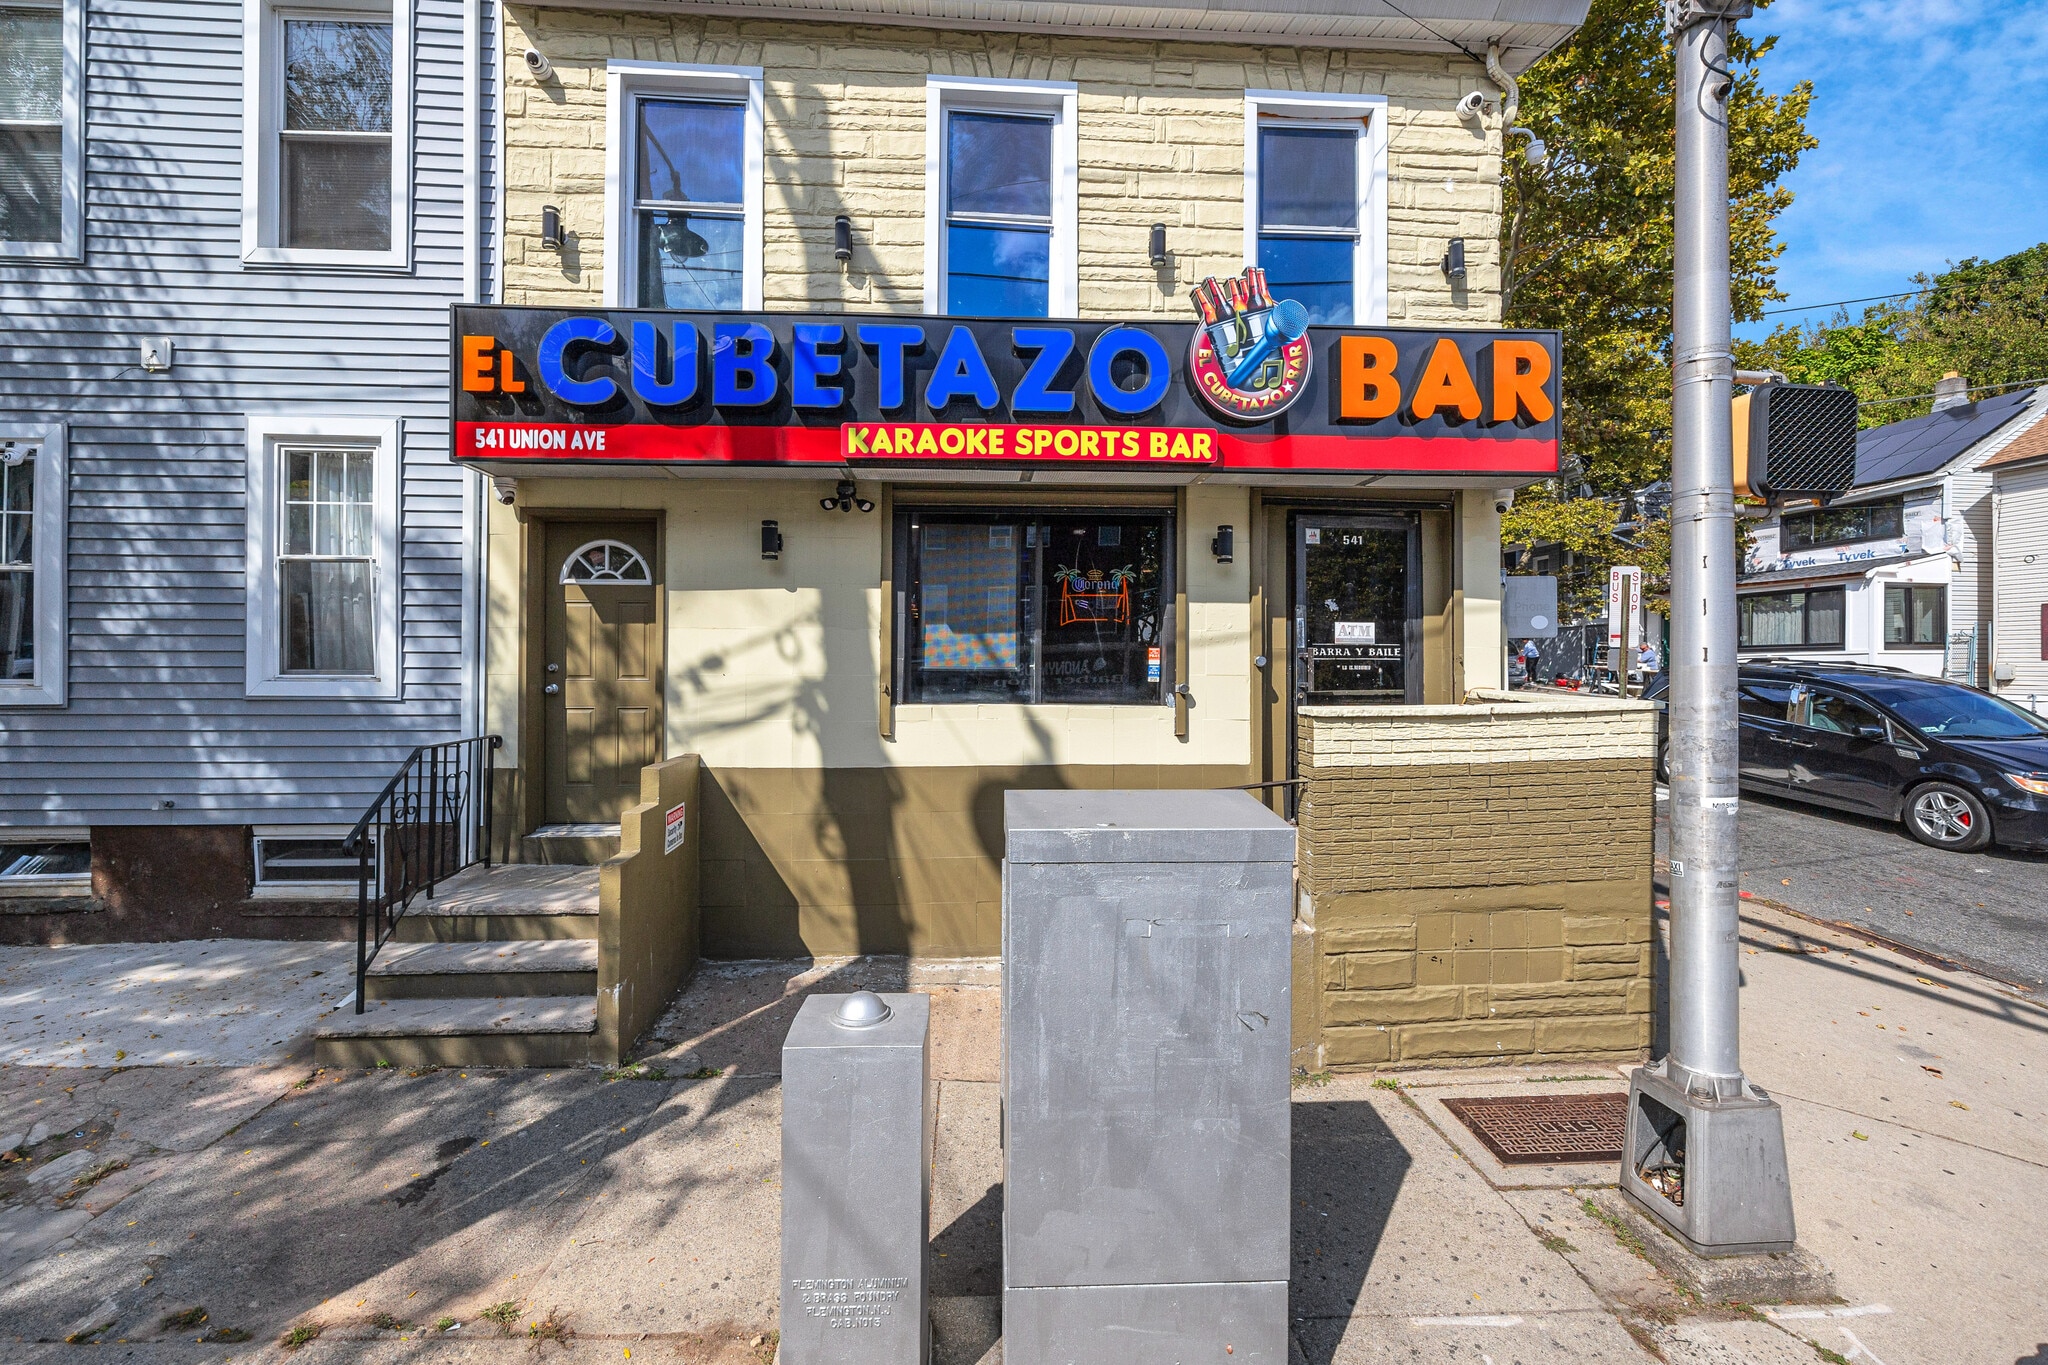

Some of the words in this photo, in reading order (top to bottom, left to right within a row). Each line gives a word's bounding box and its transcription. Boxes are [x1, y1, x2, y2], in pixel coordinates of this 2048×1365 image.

[1198, 348, 1213, 368] EL
[1286, 344, 1303, 380] BAR
[462, 335, 526, 393] EL
[537, 316, 1172, 414] CUBETAZO
[1340, 335, 1555, 422] BAR
[1203, 372, 1284, 411] CUBETAZO
[475, 428, 505, 450] 541
[509, 428, 567, 451] UNION
[570, 430, 606, 451] AVE
[847, 427, 1005, 455] KARAOKE
[1014, 429, 1141, 457] SPORTS
[1149, 432, 1212, 460] BAR
[1343, 535, 1363, 545] 541
[1837, 549, 1876, 562] Tyvek
[1072, 577, 1118, 593] Corona
[1612, 571, 1620, 603] BUS
[1631, 571, 1639, 614] STOP
[1338, 624, 1372, 637] ATM
[1313, 648, 1351, 656] BARRA
[1355, 648, 1363, 656] Y
[1368, 648, 1401, 656] BAILE
[1670, 862, 1681, 871] AXI
[792, 1278, 854, 1291] FLEMINGTON
[858, 1277, 909, 1289] ALUMINUM
[853, 1290, 900, 1302] FOUNDRY
